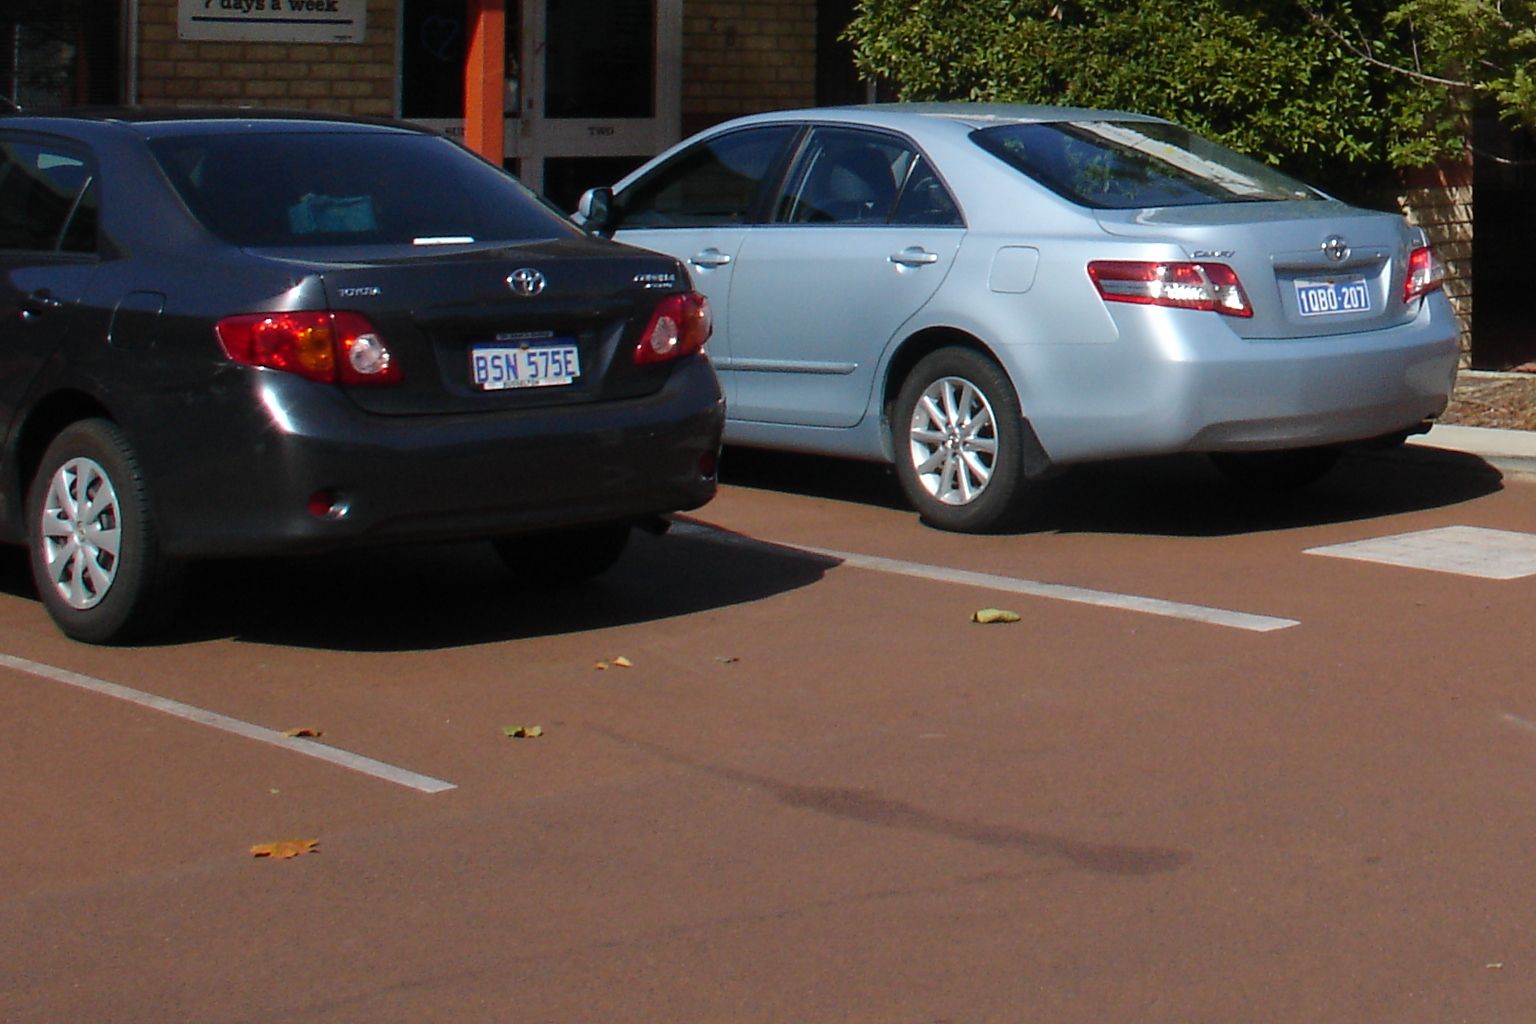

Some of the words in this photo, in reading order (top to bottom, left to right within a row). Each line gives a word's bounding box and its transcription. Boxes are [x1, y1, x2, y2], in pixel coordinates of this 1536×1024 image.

[271, 0, 281, 10] a
[475, 353, 519, 383] BSN
[527, 349, 576, 378] 575E
